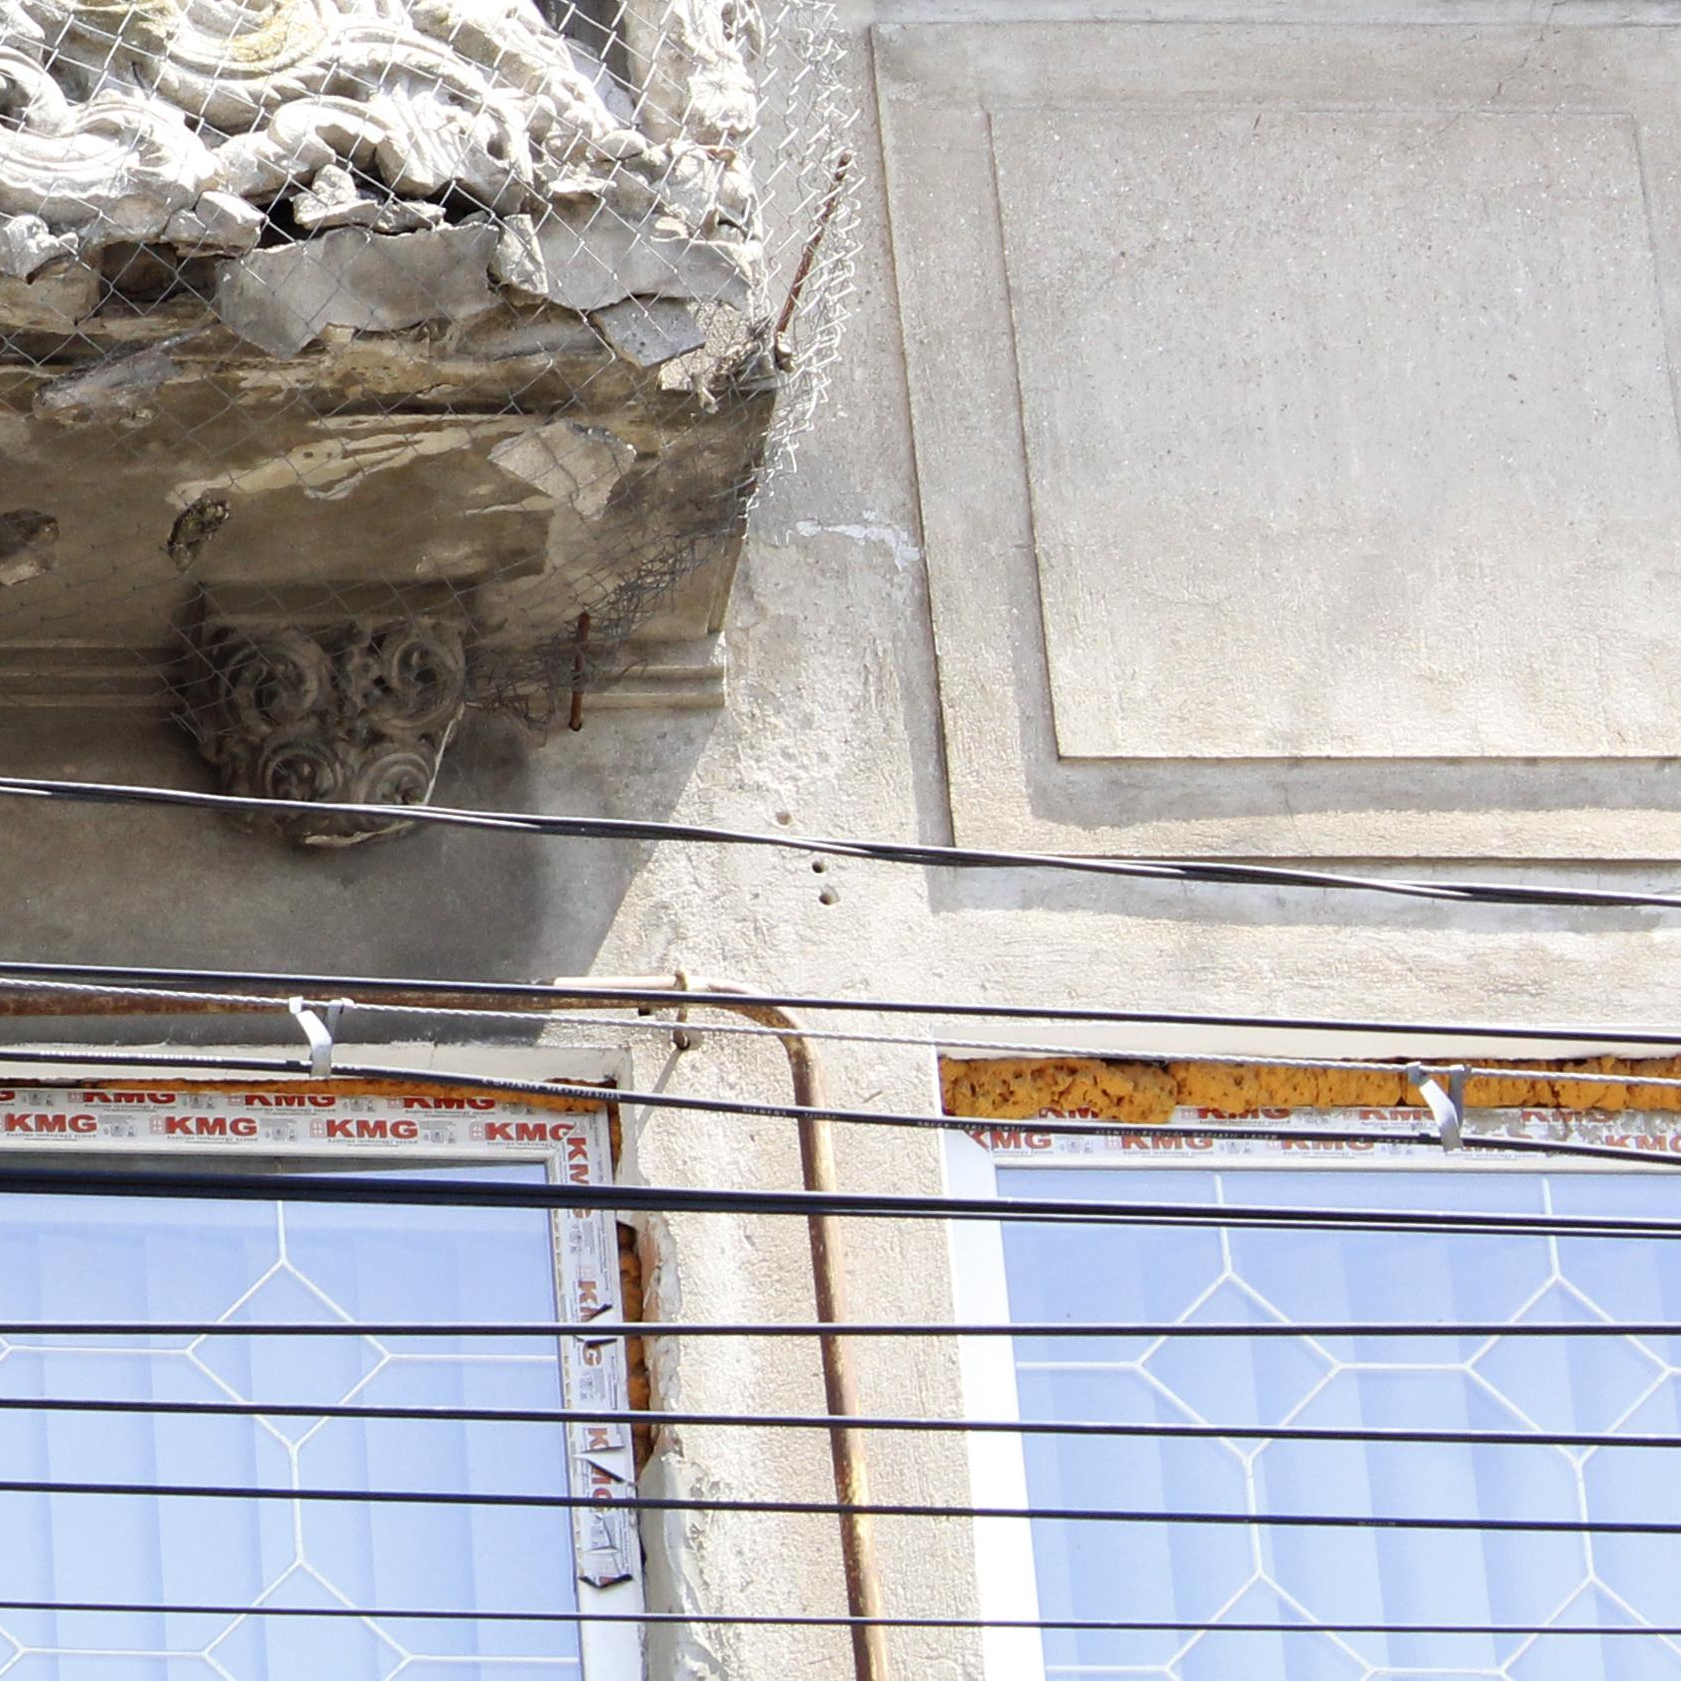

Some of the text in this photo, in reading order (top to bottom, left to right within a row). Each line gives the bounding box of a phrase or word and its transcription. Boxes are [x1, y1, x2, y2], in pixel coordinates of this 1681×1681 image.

[83, 1091, 176, 1104] KMG
[244, 1094, 336, 1107] KMG
[403, 1097, 496, 1109] KMG
[4, 1113, 97, 1132] KMG
[165, 1116, 258, 1136] KMG
[326, 1119, 418, 1138] KMG
